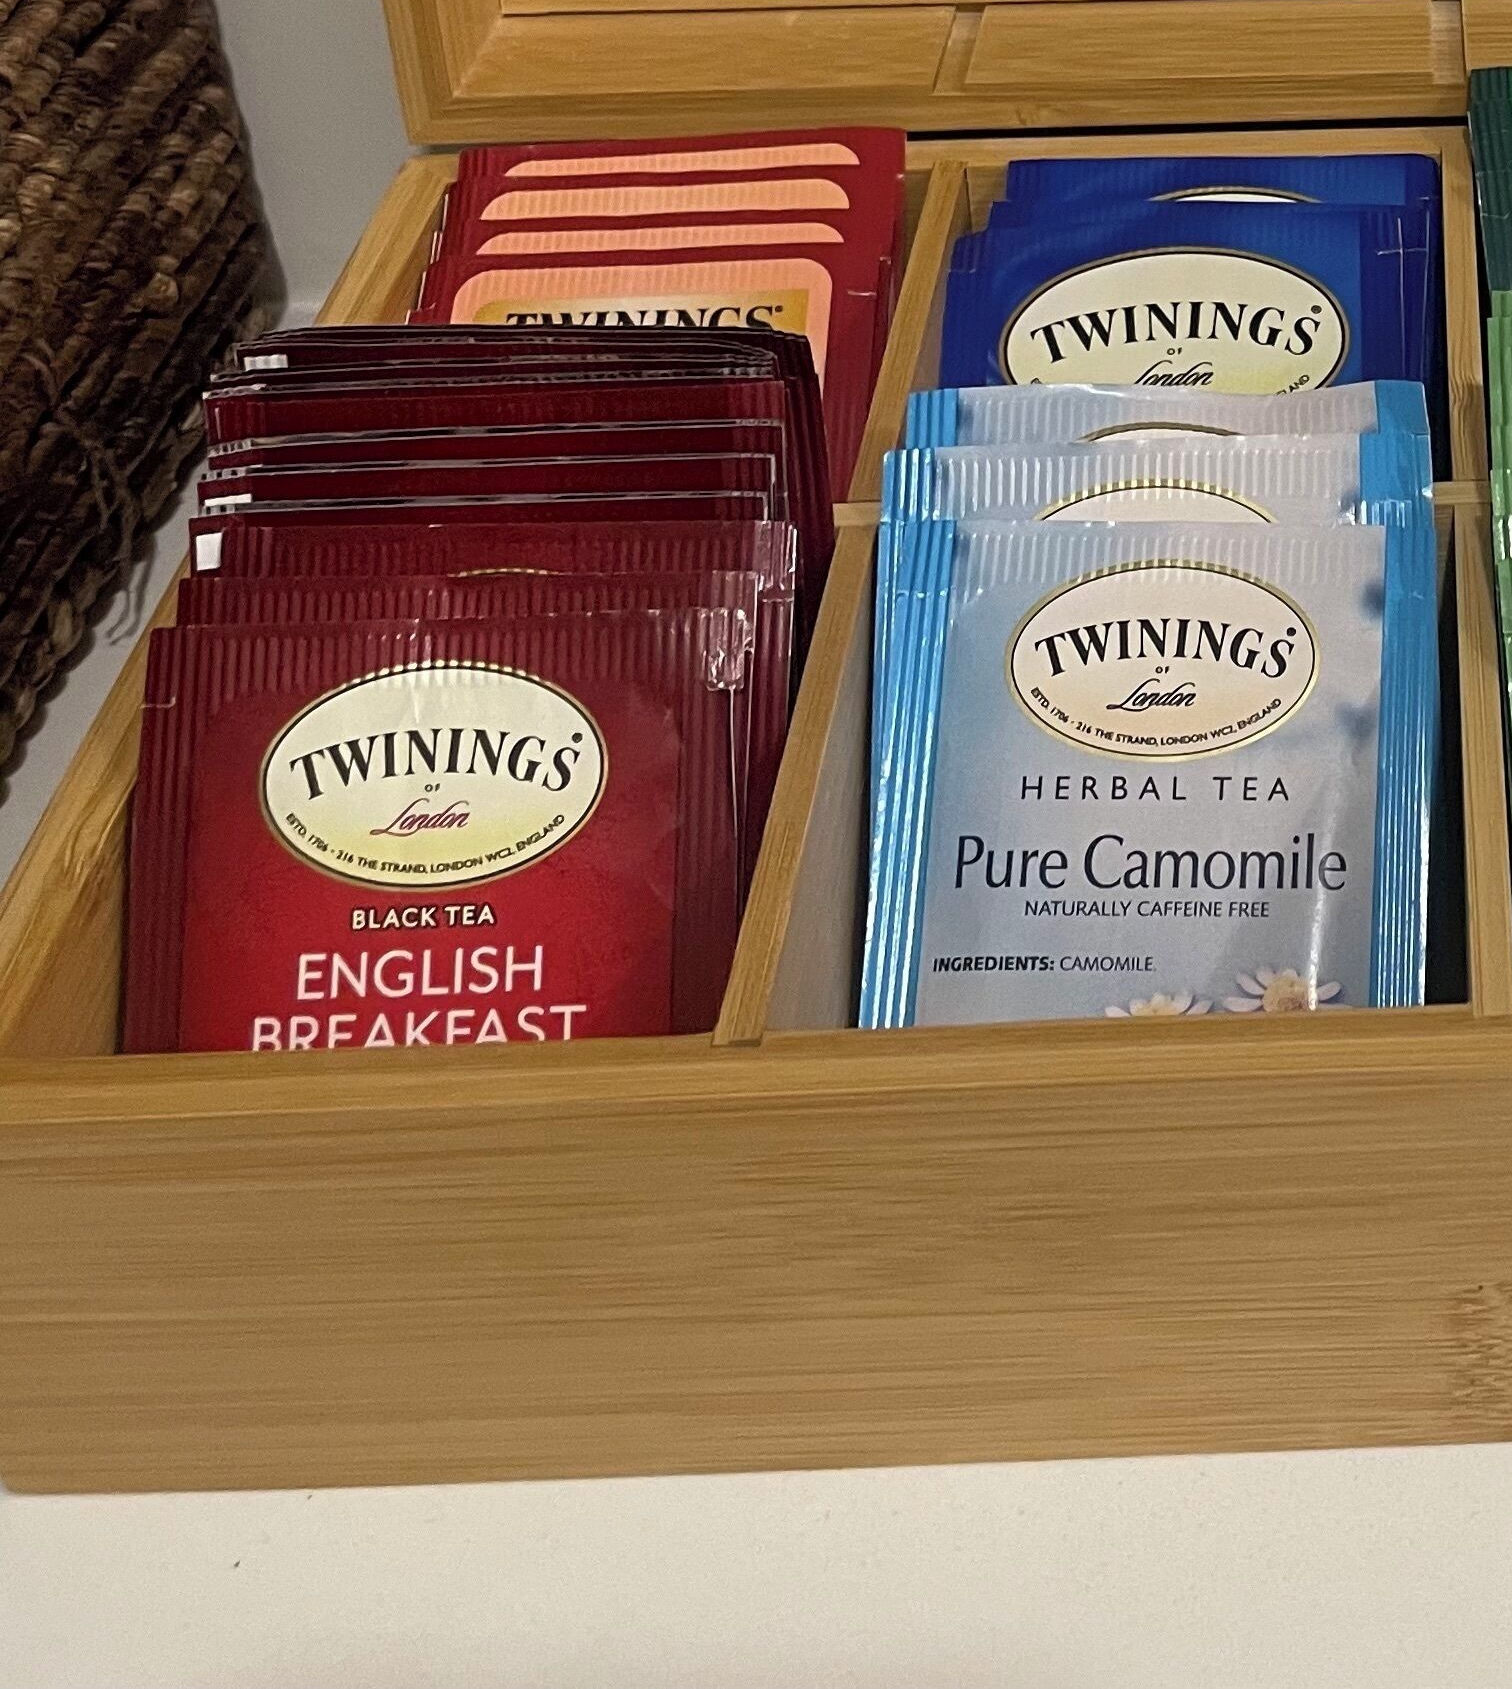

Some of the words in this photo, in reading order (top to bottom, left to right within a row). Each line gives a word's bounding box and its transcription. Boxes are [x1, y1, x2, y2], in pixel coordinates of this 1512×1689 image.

[1166, 347, 1183, 356] OF
[1155, 665, 1170, 674] OF
[1106, 678, 1196, 712] London
[1050, 706, 1069, 723] 1706
[1075, 721, 1092, 734] 216
[1095, 727, 1114, 741] THE
[1160, 732, 1208, 746] LONDON
[1237, 698, 1282, 730] ENGLAND
[424, 783, 440, 793] OF
[1020, 775, 1187, 801] HERBAL
[1213, 776, 1290, 801] TEA
[369, 797, 470, 837] London
[307, 834, 329, 852] 1706
[336, 849, 354, 864] 216
[357, 856, 378, 870] THE
[430, 856, 483, 873] LONDON
[516, 814, 565, 852] ENGLAND
[954, 834, 1069, 890] Pure
[1083, 832, 1348, 891] Camomile
[351, 905, 437, 931] BLACK
[444, 904, 495, 927] TEA
[1024, 900, 1132, 918] NATURALLY
[1137, 900, 1223, 918] CAFFEINE
[1228, 901, 1270, 919] FREE
[297, 945, 543, 1000] ENGLISH
[932, 956, 1055, 973] INGREDIENTS:
[252, 1004, 587, 1051] BREAKFAST
